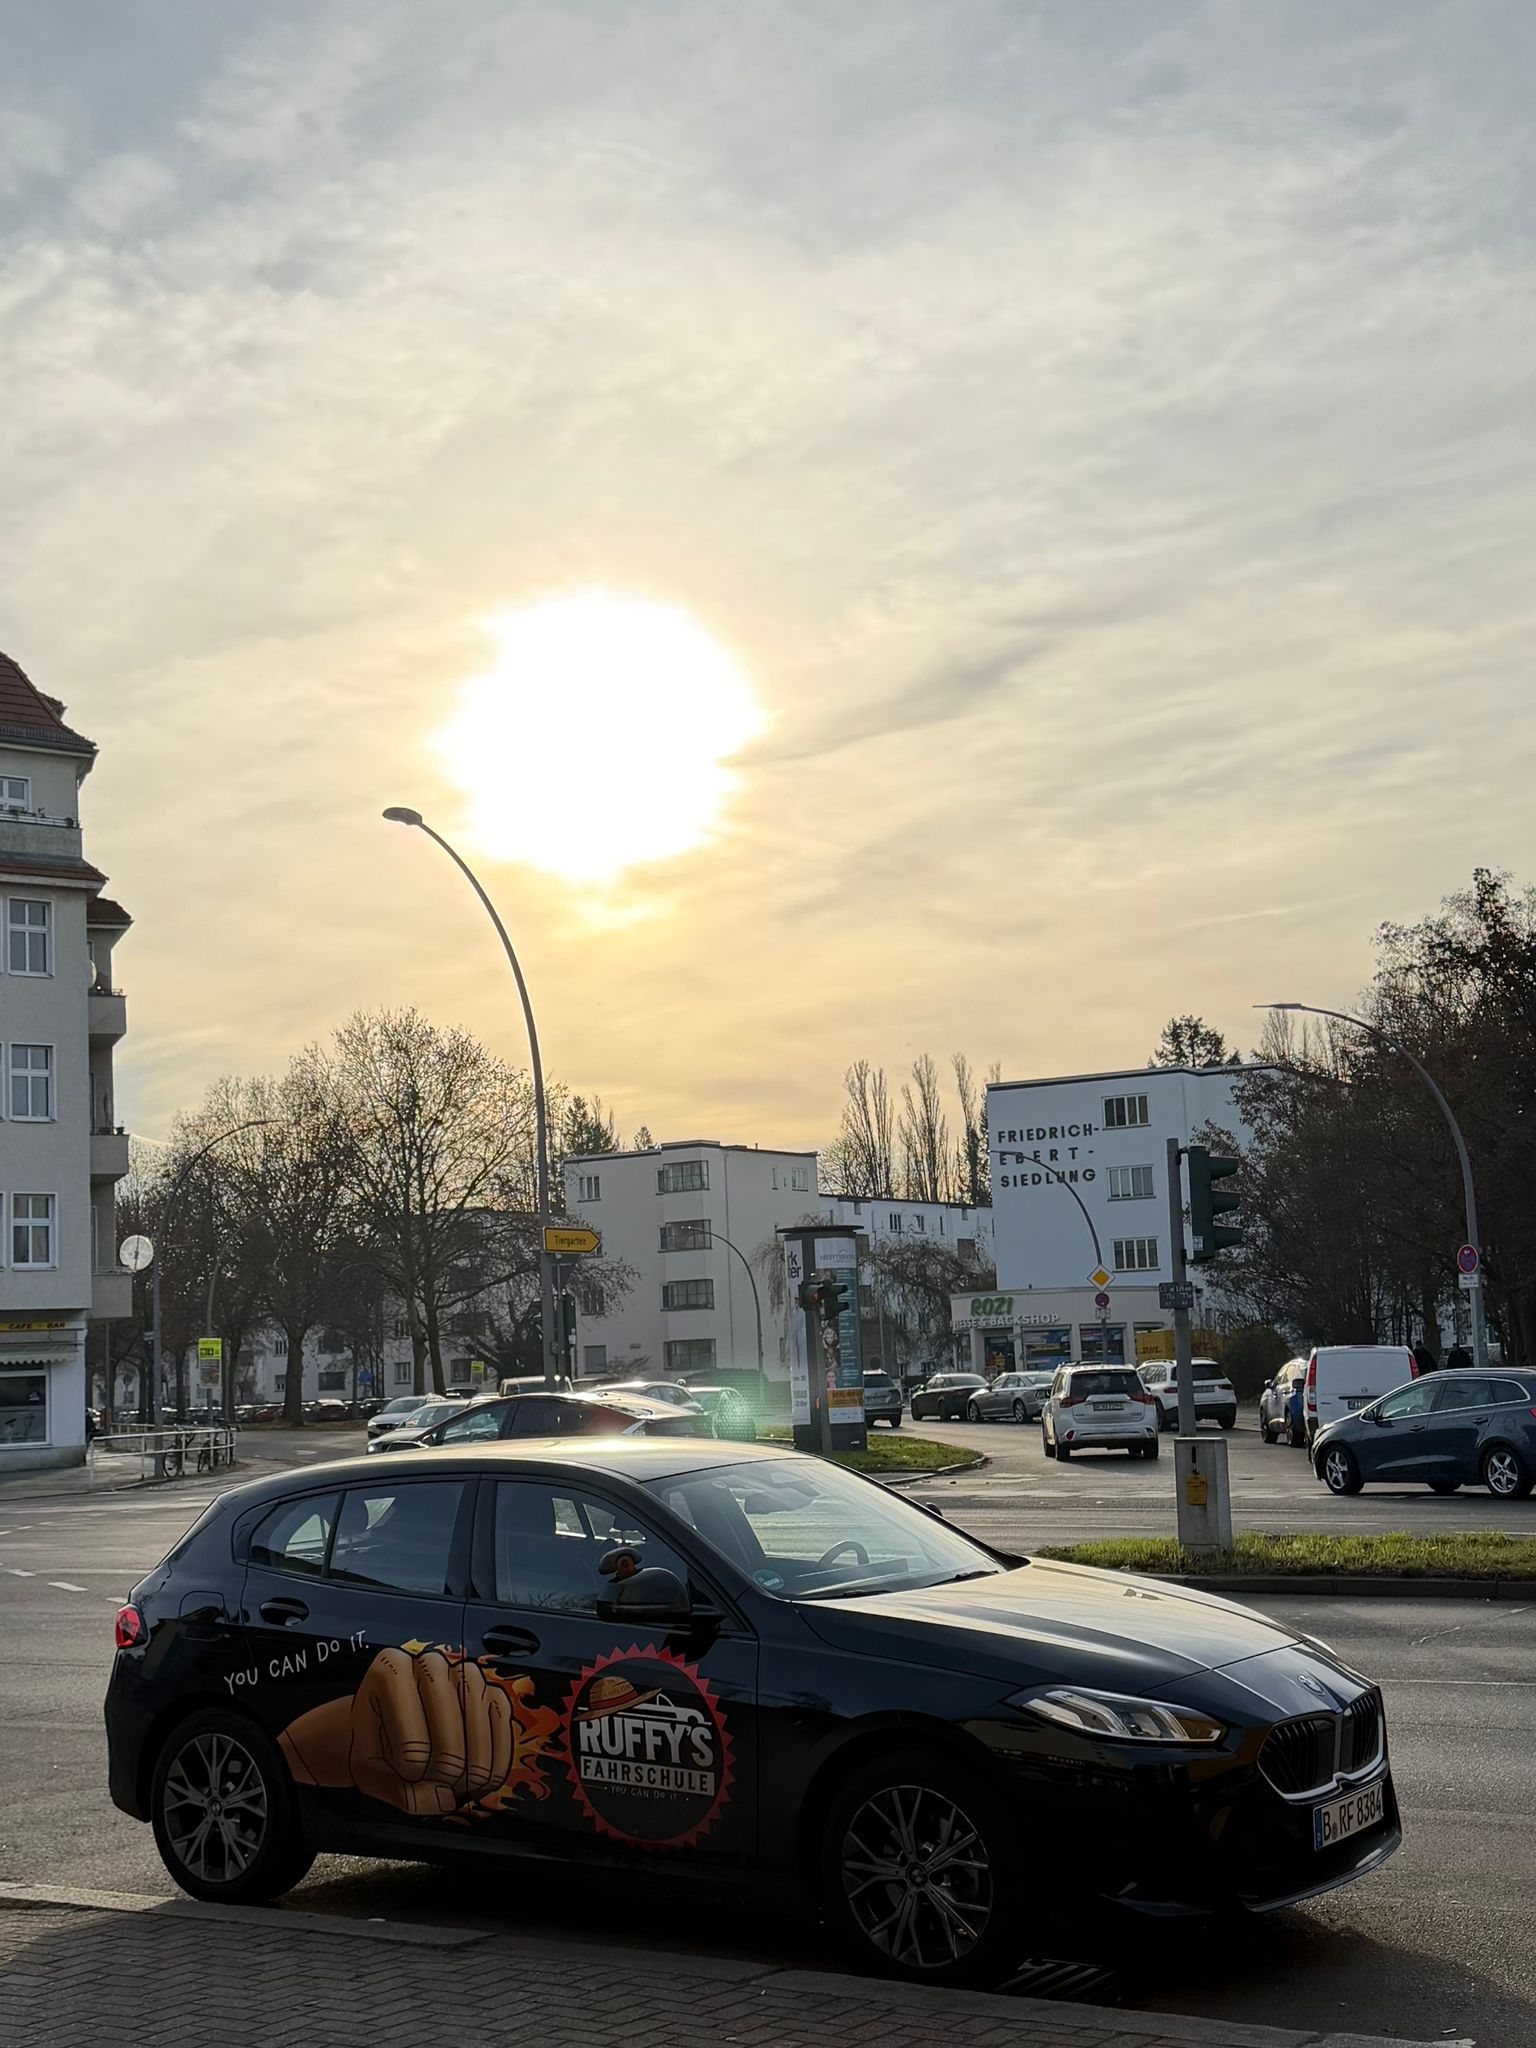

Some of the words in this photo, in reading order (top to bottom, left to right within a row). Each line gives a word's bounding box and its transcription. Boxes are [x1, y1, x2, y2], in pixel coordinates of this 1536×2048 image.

[998, 1123, 1099, 1143] FRIEDRICH-
[1001, 1168, 1096, 1188] SIEDLUNG
[554, 1235, 587, 1247] Tiergarten
[971, 1297, 1014, 1316] ROZI
[990, 1313, 1060, 1326] BACKSHOP
[224, 1667, 258, 1695] YOU
[269, 1650, 307, 1677] CAN
[316, 1640, 340, 1662] DO
[351, 1630, 369, 1652] IT.
[583, 1758, 708, 1792] FAHRSCHULE
[610, 1784, 627, 1795] YOU
[630, 1787, 649, 1799] CAN
[1323, 1811, 1331, 1840] B
[1339, 1800, 1354, 1834] RF
[1357, 1785, 1381, 1826] 8384
